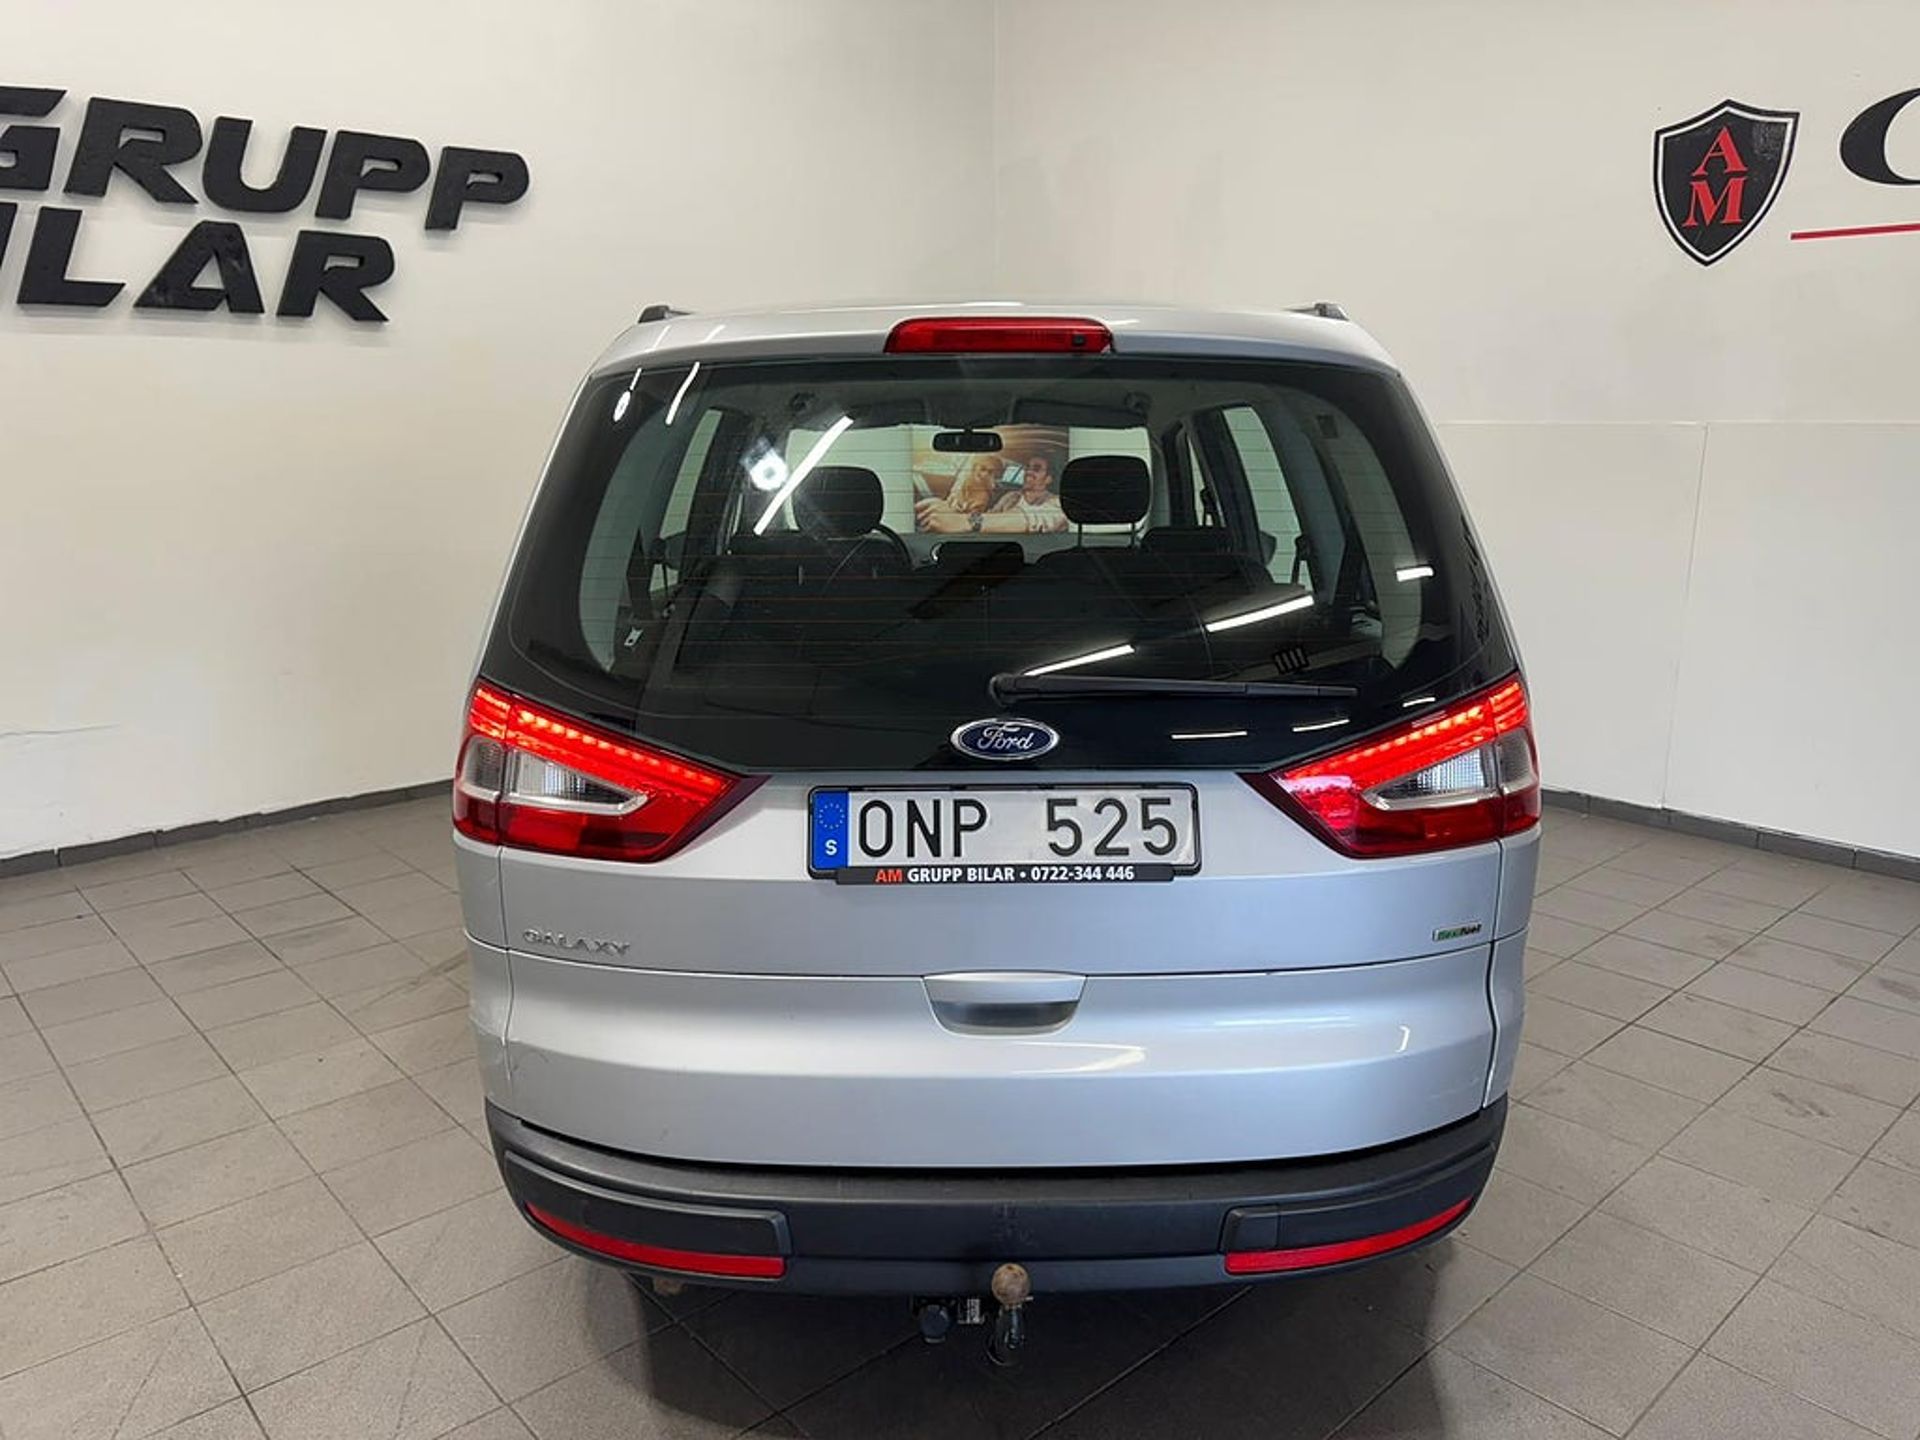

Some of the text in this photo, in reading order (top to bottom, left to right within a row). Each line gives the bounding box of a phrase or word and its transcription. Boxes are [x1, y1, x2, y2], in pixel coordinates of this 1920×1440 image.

[977, 725, 1034, 750] Ford
[859, 797, 1177, 858] ONP 525
[825, 839, 838, 856] S
[875, 865, 1134, 883] AM GRUPP BILAR 0722-344 446
[523, 929, 631, 956] GALAXY
